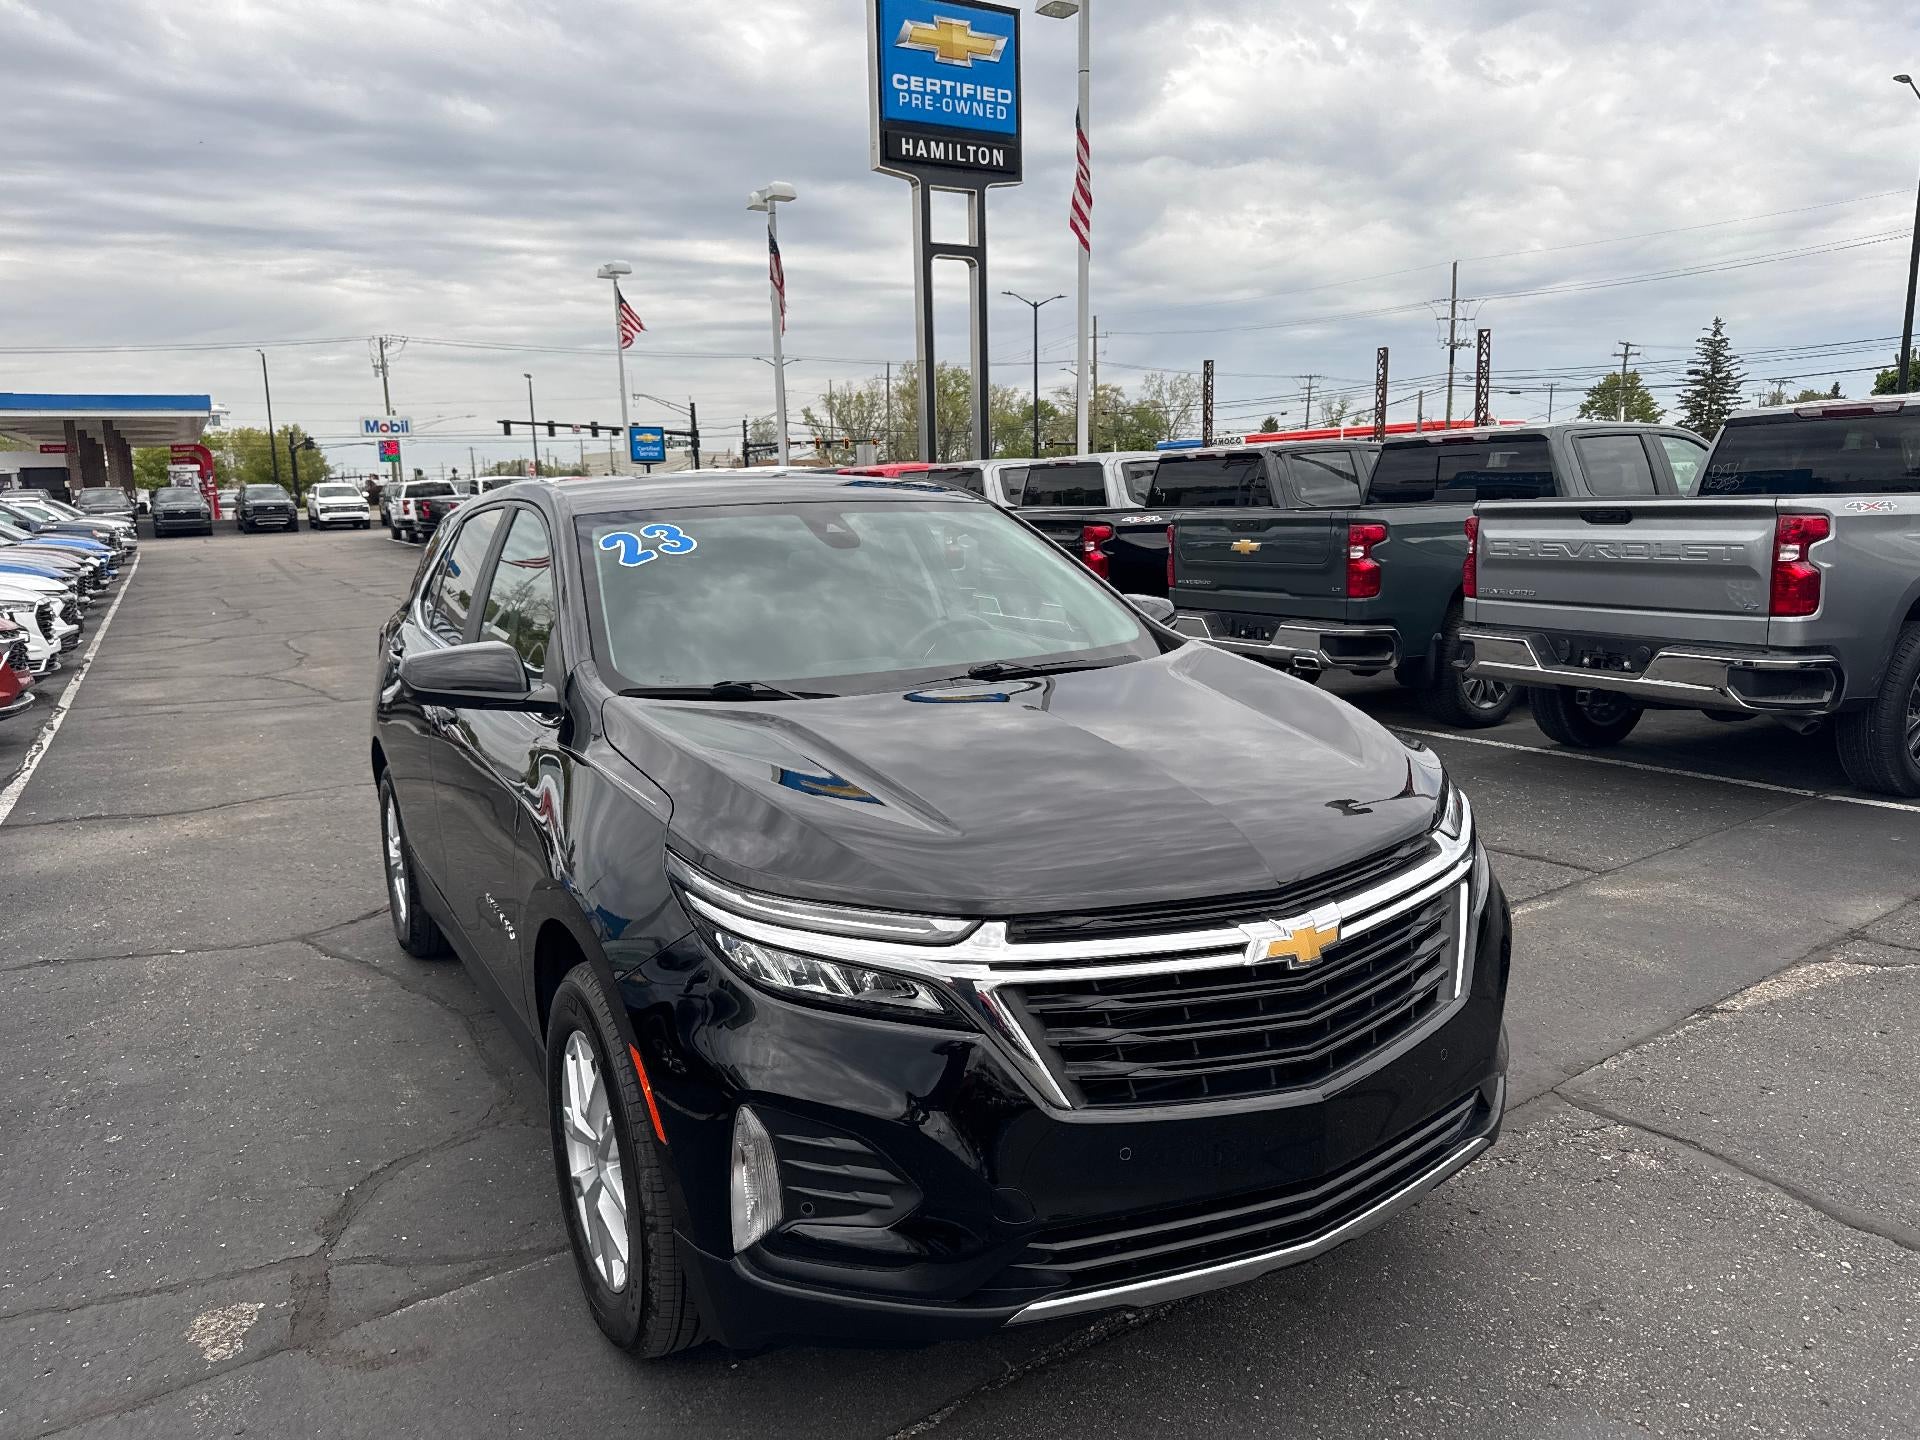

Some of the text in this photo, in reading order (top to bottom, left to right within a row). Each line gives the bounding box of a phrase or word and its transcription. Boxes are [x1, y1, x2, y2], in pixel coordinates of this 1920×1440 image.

[891, 73, 1012, 104] CERTIFIED
[899, 92, 1007, 120] PRE-OWNED
[901, 137, 1004, 167] HAMILTON
[364, 420, 409, 433] Mobil
[599, 523, 698, 567] 23
[1488, 540, 1745, 561] CHEVROLET
